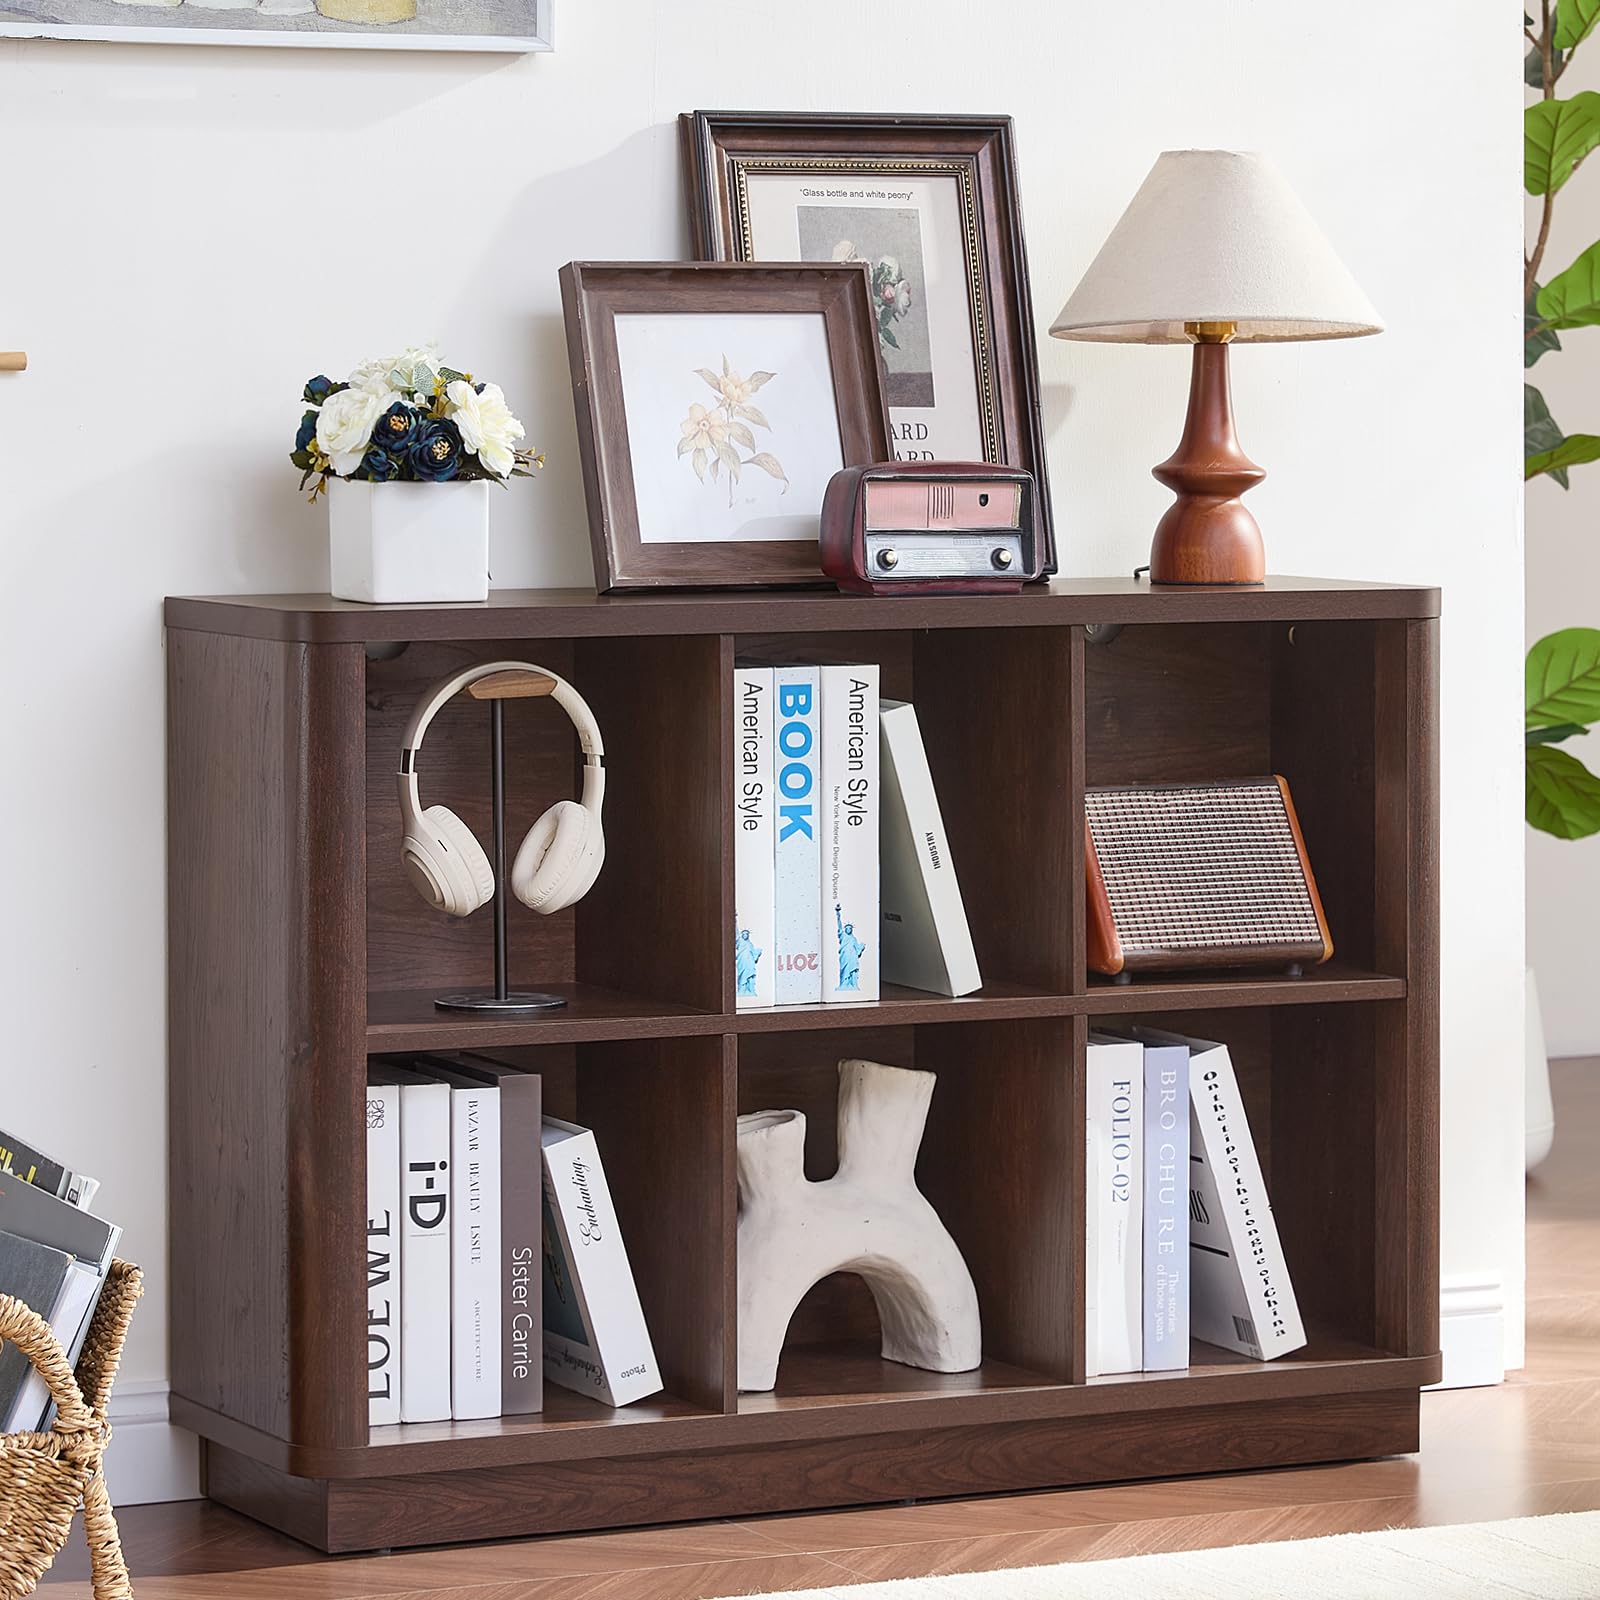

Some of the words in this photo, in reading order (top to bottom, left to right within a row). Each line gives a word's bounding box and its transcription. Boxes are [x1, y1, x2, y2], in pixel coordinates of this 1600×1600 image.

[826, 189, 848, 198] bottle
[849, 190, 864, 198] and
[865, 190, 886, 199] white
[743, 681, 763, 775] American
[848, 678, 870, 771] American
[779, 683, 813, 843] BOOK
[738, 782, 763, 831] Style
[833, 785, 841, 801] New
[833, 803, 841, 818] York
[843, 778, 869, 827] Style
[832, 820, 840, 845] Interior
[925, 831, 942, 870] INDUSTRY
[831, 846, 840, 872] Design
[777, 952, 819, 971] 2011
[468, 1099, 479, 1151] BAZAAR
[1111, 1079, 1131, 1203] FOLIO-02
[409, 1160, 448, 1230] i-D
[512, 1247, 533, 1308] Sister
[1168, 1271, 1179, 1294] The
[367, 1209, 390, 1400] LOEWE
[1154, 1311, 1164, 1342] years
[512, 1313, 533, 1379] Carrie
[620, 1364, 647, 1379] Photo
